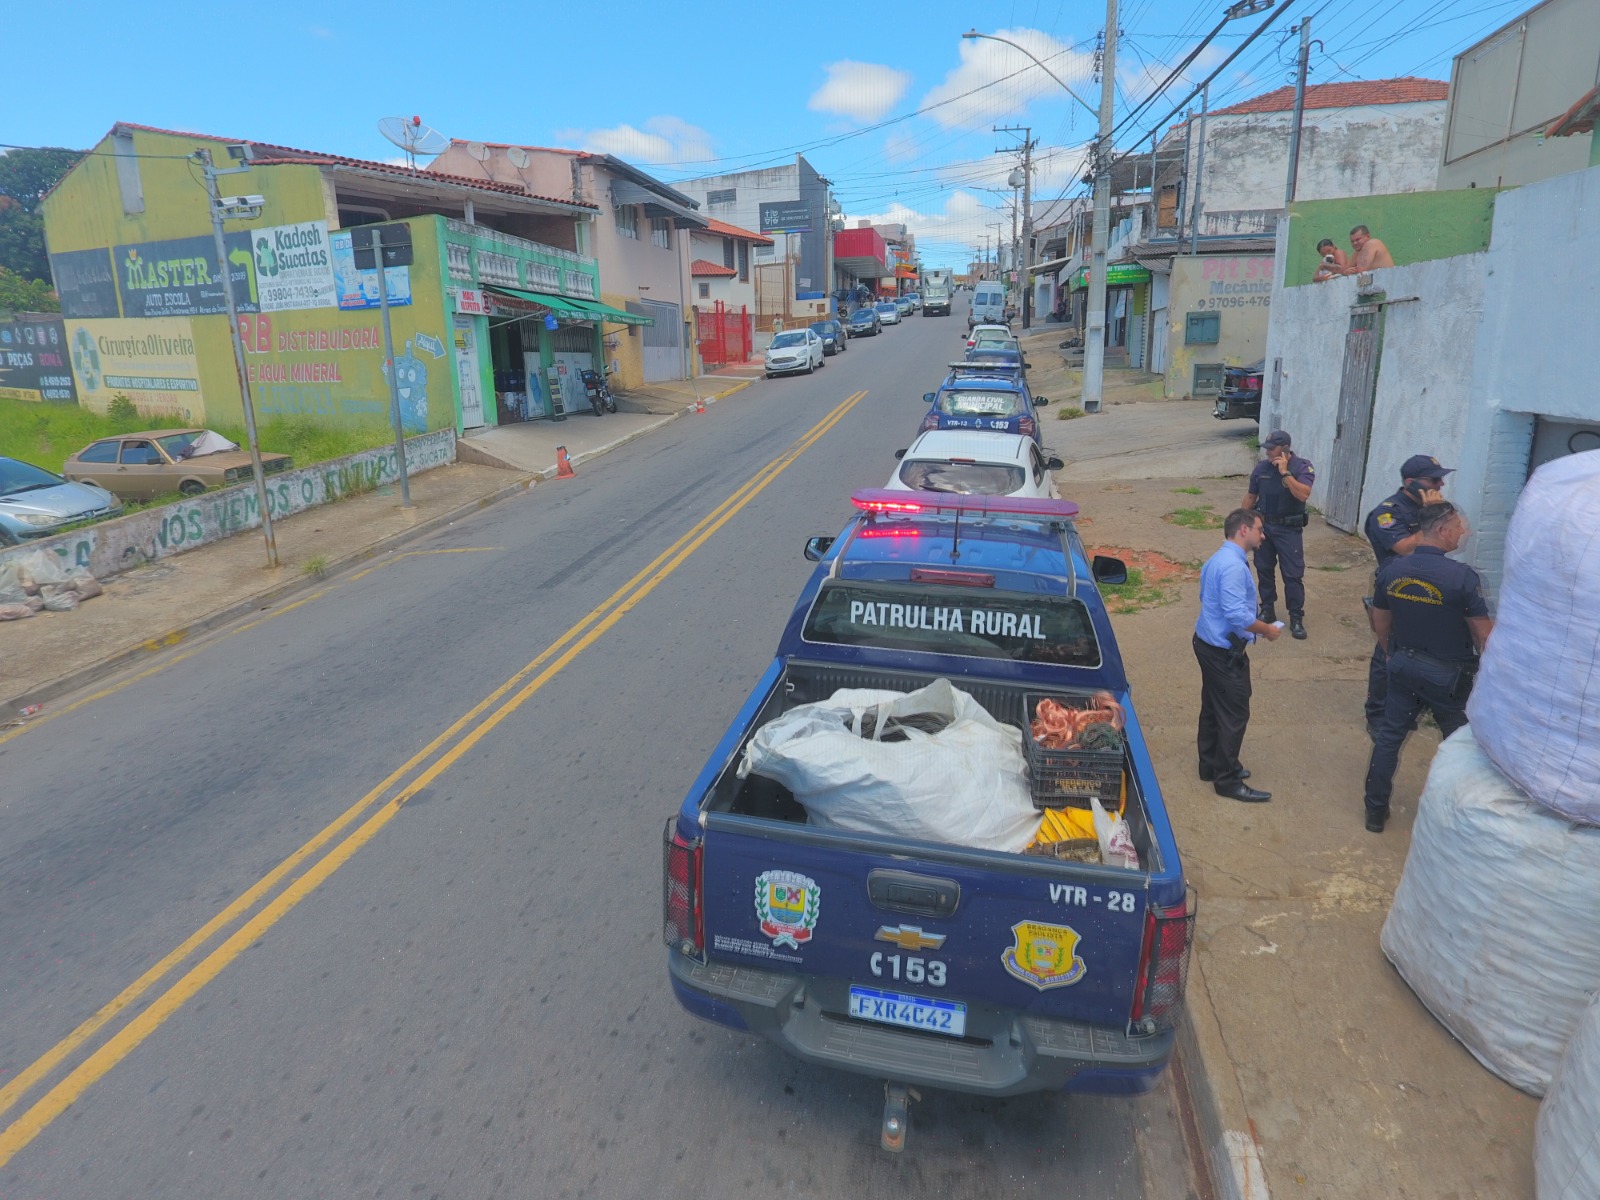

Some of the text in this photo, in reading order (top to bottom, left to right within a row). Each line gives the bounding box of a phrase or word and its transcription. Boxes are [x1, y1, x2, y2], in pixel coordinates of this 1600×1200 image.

[275, 224, 322, 250] Kadosh
[279, 247, 328, 270] Sucatas
[1201, 257, 1239, 281] Pit
[126, 256, 212, 290] MASTER
[146, 294, 163, 307] AUTO
[165, 292, 191, 306] ESCOLA
[237, 314, 273, 354] RB
[277, 326, 380, 353] DISTRIBUIDORA
[7, 352, 34, 369] PEÇAS
[289, 362, 342, 383] MINERAL
[106, 376, 131, 388] PRODUTOS
[132, 377, 165, 390] HOSPITALARES
[957, 401, 1004, 411] MUNICIPAL
[986, 396, 1005, 404] CIVIL
[995, 421, 1010, 429] 153
[301, 478, 314, 502] O
[850, 600, 1046, 640] PATRULHA RURAL
[1049, 883, 1087, 907] VTR
[1107, 891, 1136, 913] 28
[887, 954, 947, 987] 153
[859, 998, 953, 1029] FXR4C42
